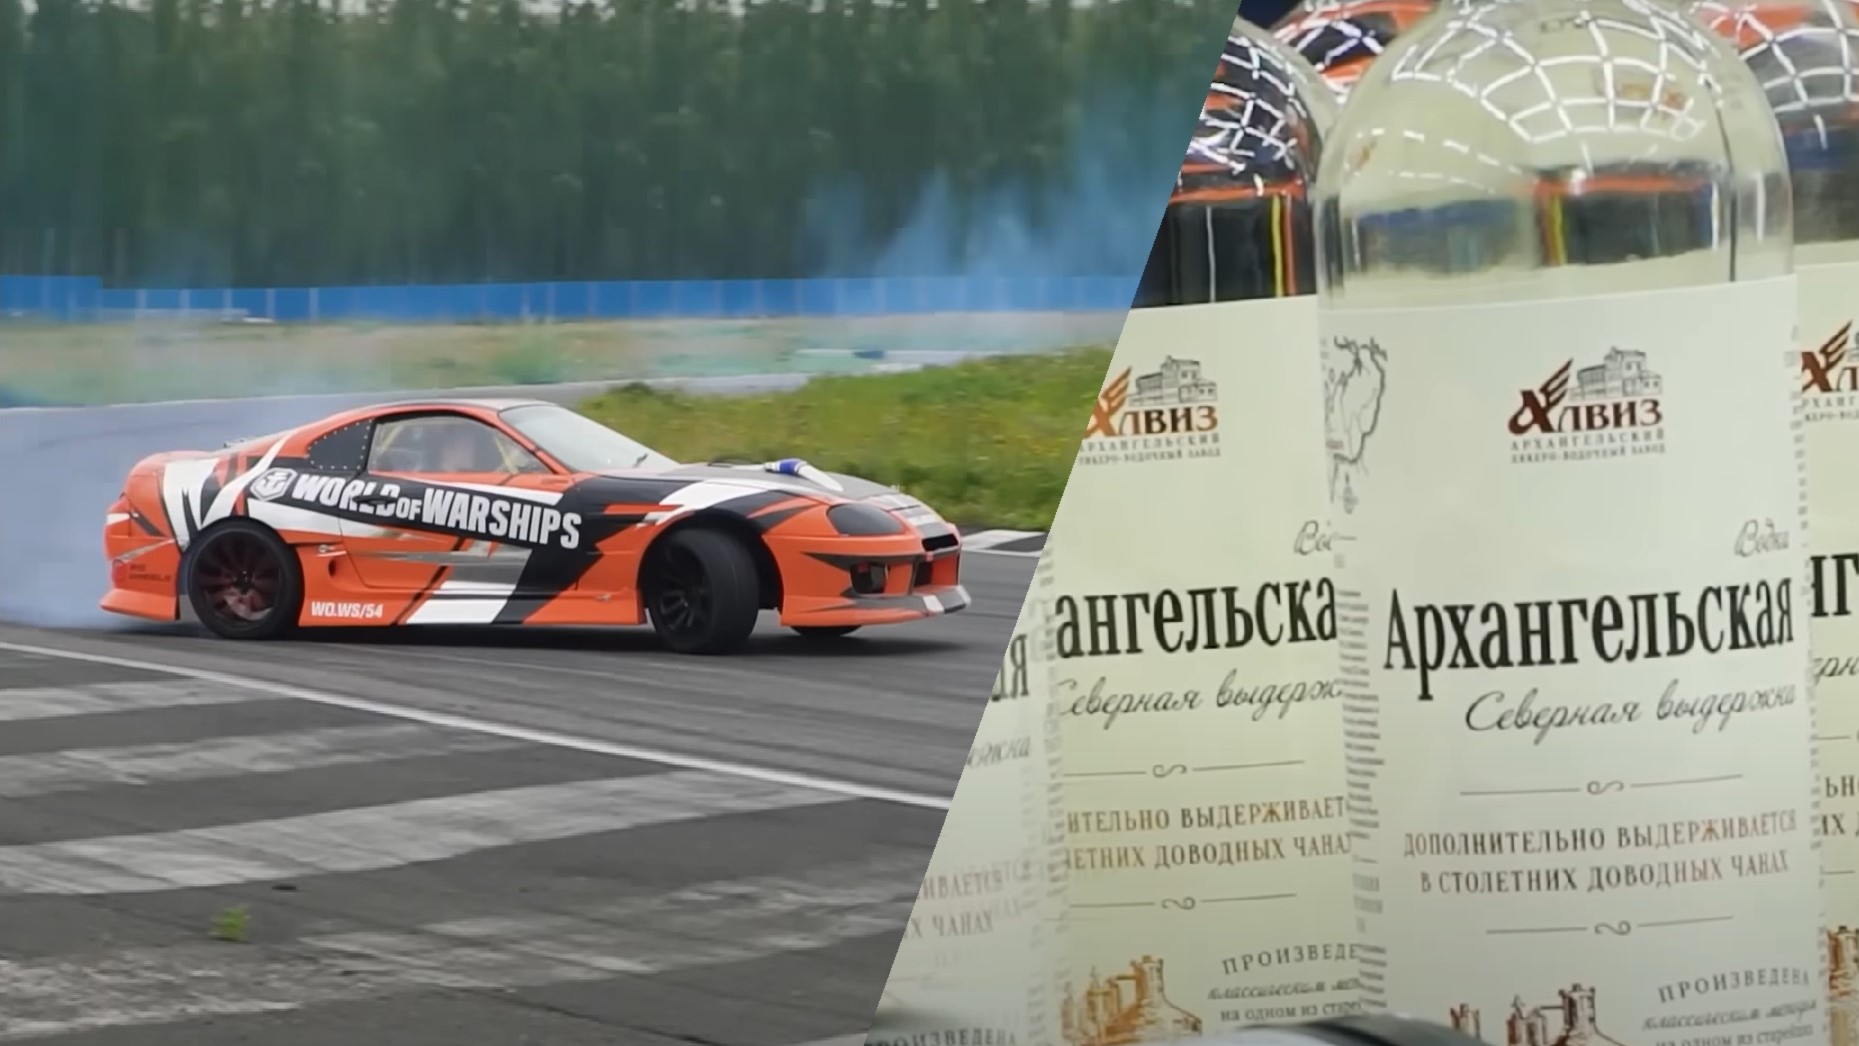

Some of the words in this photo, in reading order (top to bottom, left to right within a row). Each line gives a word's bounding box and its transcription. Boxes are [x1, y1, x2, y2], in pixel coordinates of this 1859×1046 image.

[292, 474, 400, 517] WORLD
[396, 496, 423, 520] OF
[422, 487, 582, 549] WARSHIPS
[310, 601, 384, 619] WO.WS/54
[1055, 577, 1337, 659] ангельска
[1384, 577, 1794, 700] Архангельская
[1465, 689, 1641, 745] Северная
[1655, 679, 1796, 733] выдержка
[1154, 837, 1286, 870] ДОВОДНЫХ
[1404, 826, 1605, 857] ДОПОЛНИТЕЛЬНО
[1617, 808, 1797, 850] ВЫДЕРЖИВАЕТСЯ
[1420, 871, 1432, 893] В
[1438, 868, 1578, 894] СТОЛЕТНИХ
[1587, 862, 1724, 892] ДОВОДНЫХ
[1731, 849, 1789, 877] ЧАНАХ
[1657, 967, 1810, 1004] ПРОИЗВЕДЕНА
